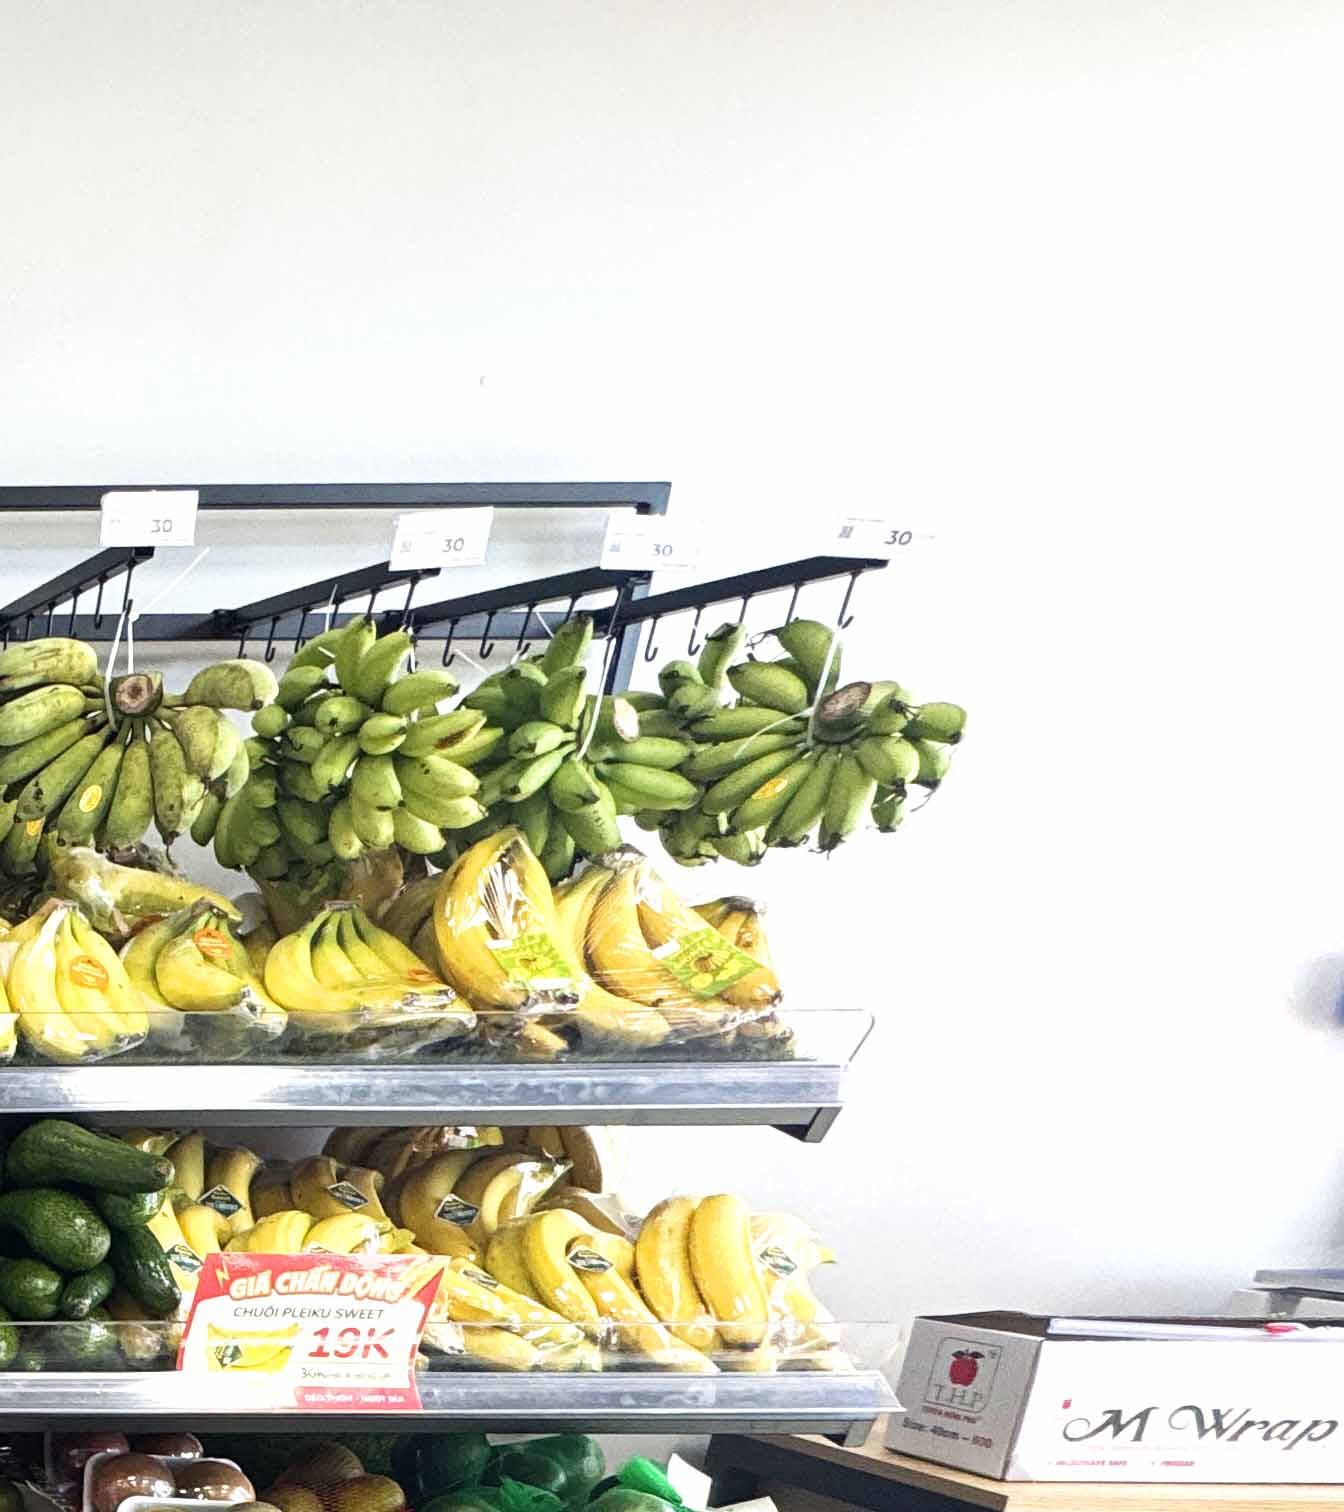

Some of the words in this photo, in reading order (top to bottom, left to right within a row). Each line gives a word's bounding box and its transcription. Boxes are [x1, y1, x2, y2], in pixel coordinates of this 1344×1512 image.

[150, 517, 173, 533] 30
[442, 537, 465, 553] 30
[884, 530, 913, 546] 30
[653, 543, 674, 557] 30
[282, 1307, 332, 1320] PLEIKU
[334, 1308, 385, 1320] SWEET
[307, 1327, 396, 1359] 19K
[1062, 1403, 1159, 1443] M
[1168, 1403, 1340, 1452] Wrap
